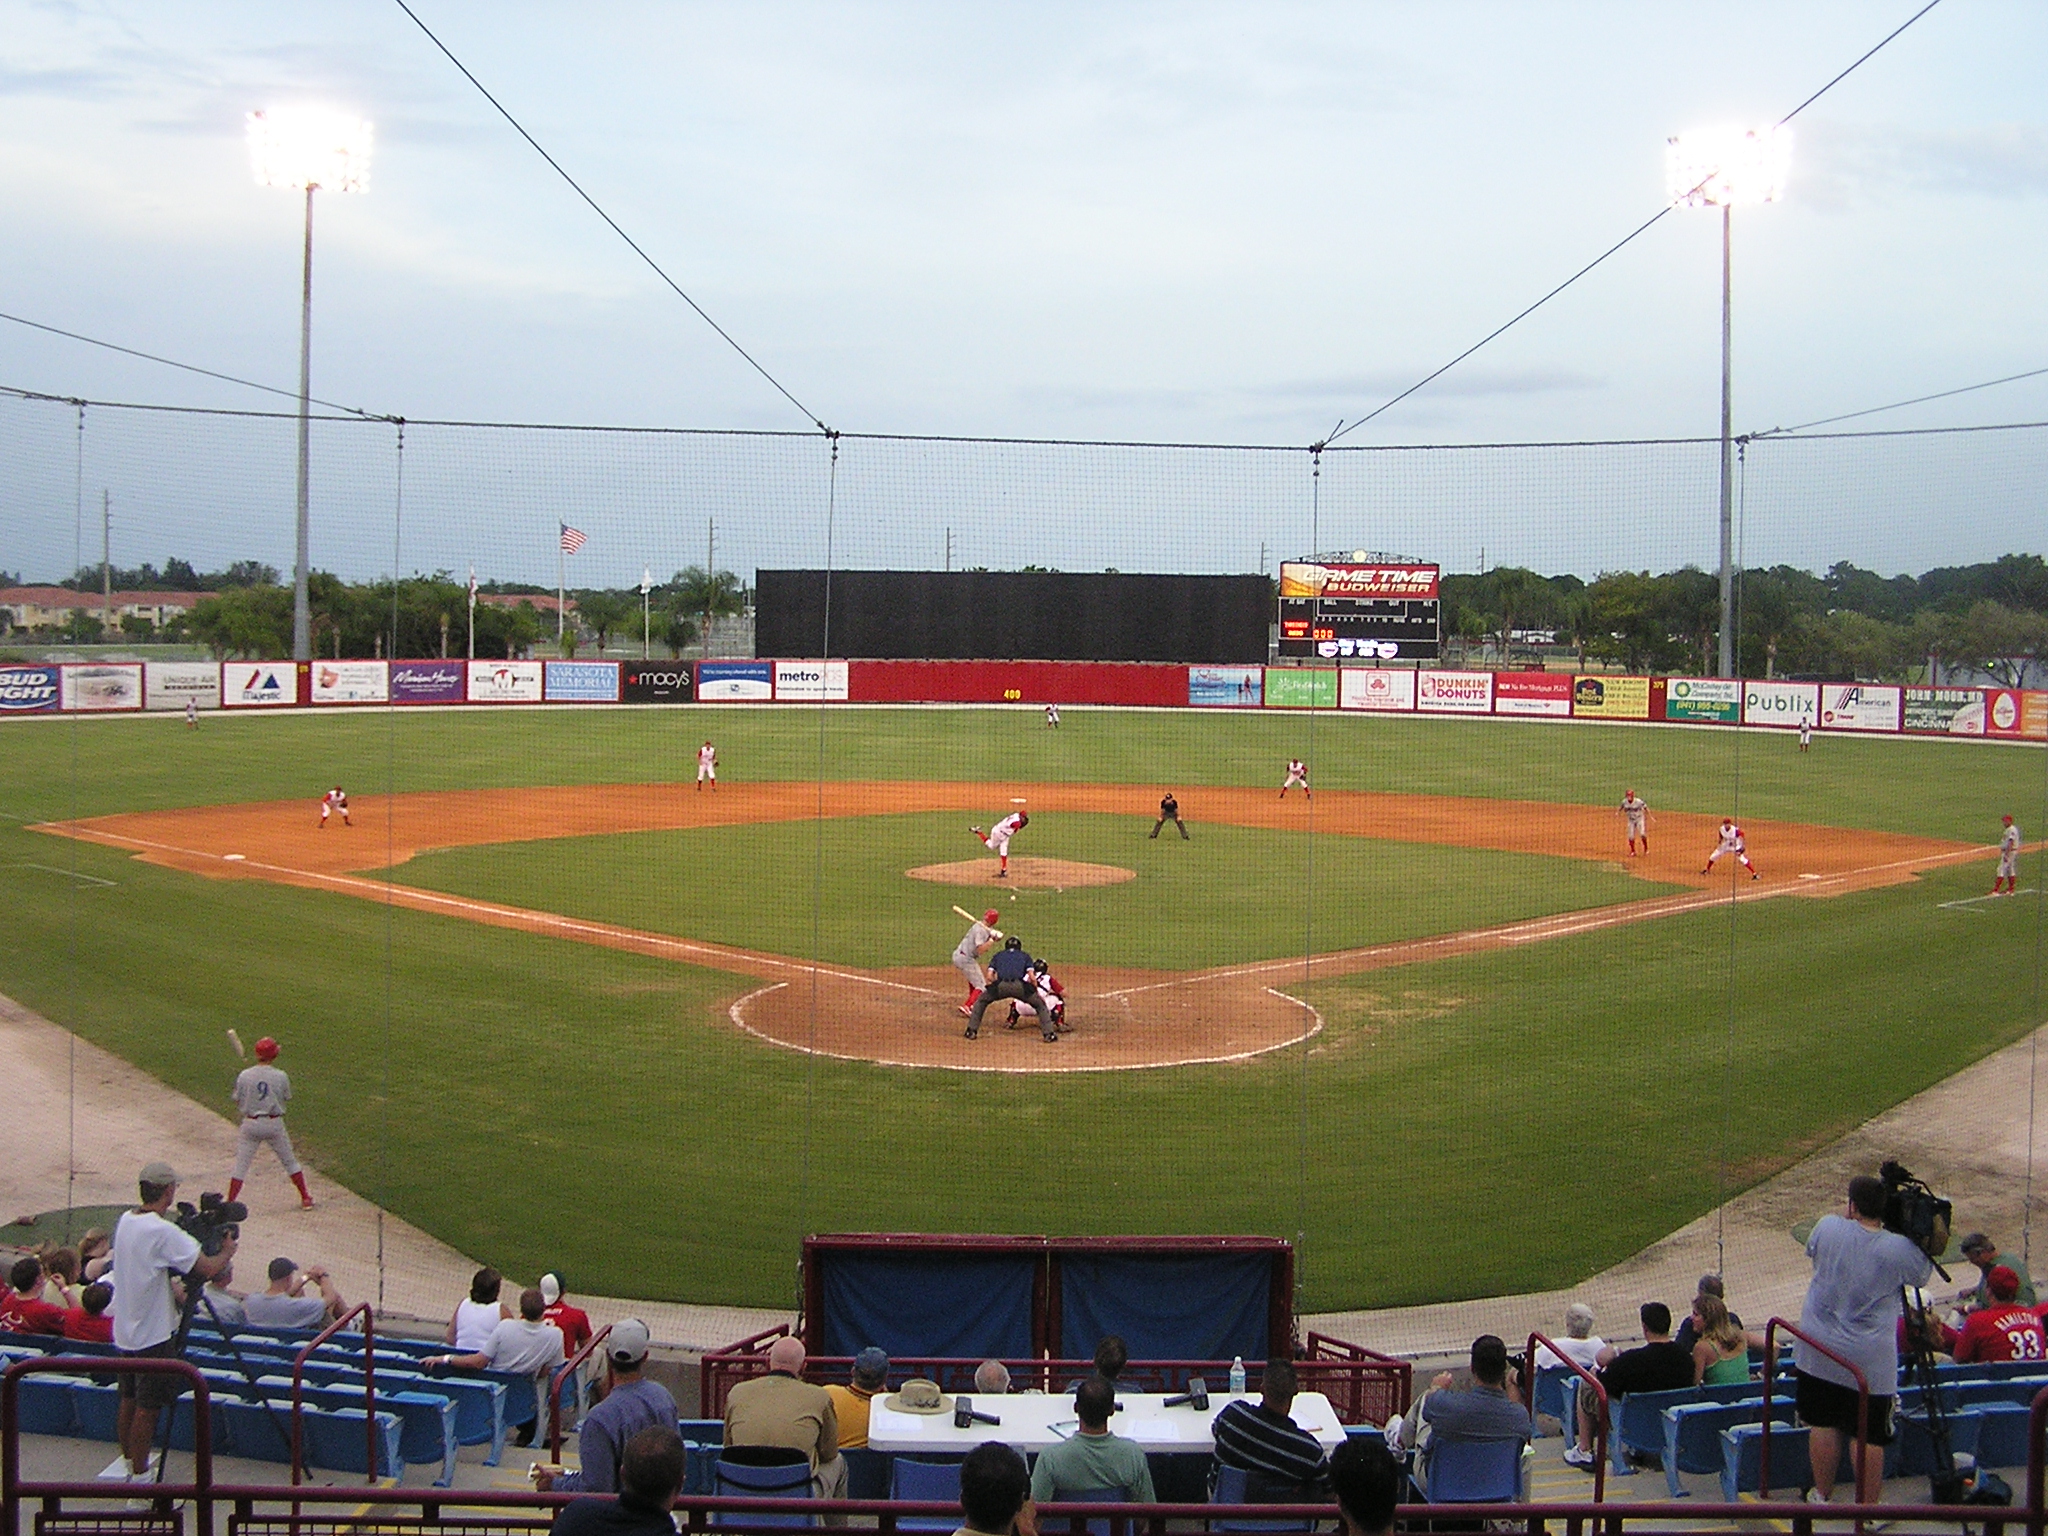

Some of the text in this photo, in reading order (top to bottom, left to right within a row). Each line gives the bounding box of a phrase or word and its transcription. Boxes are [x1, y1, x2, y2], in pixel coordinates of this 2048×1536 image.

[1303, 570, 1437, 584] GAME TIME
[1327, 583, 1430, 593] BUDWEISER
[550, 667, 615, 677] SARASOTA
[549, 677, 613, 688] MEMORIAL
[639, 670, 691, 689] macy's
[1437, 678, 1489, 689] DUNKIN'
[0, 686, 57, 700] IGHT
[243, 690, 282, 702] Majestic
[1003, 689, 1021, 700] 400
[1436, 688, 1486, 700] DONUTS
[1842, 687, 1892, 710] American
[1905, 688, 1931, 701] JOHN
[1747, 693, 1813, 713] Publix
[1904, 718, 1953, 729] CINCINNA
[256, 1080, 269, 1102] 9
[1994, 1312, 2040, 1332] HAMILTON
[2008, 1328, 2041, 1360] 33
